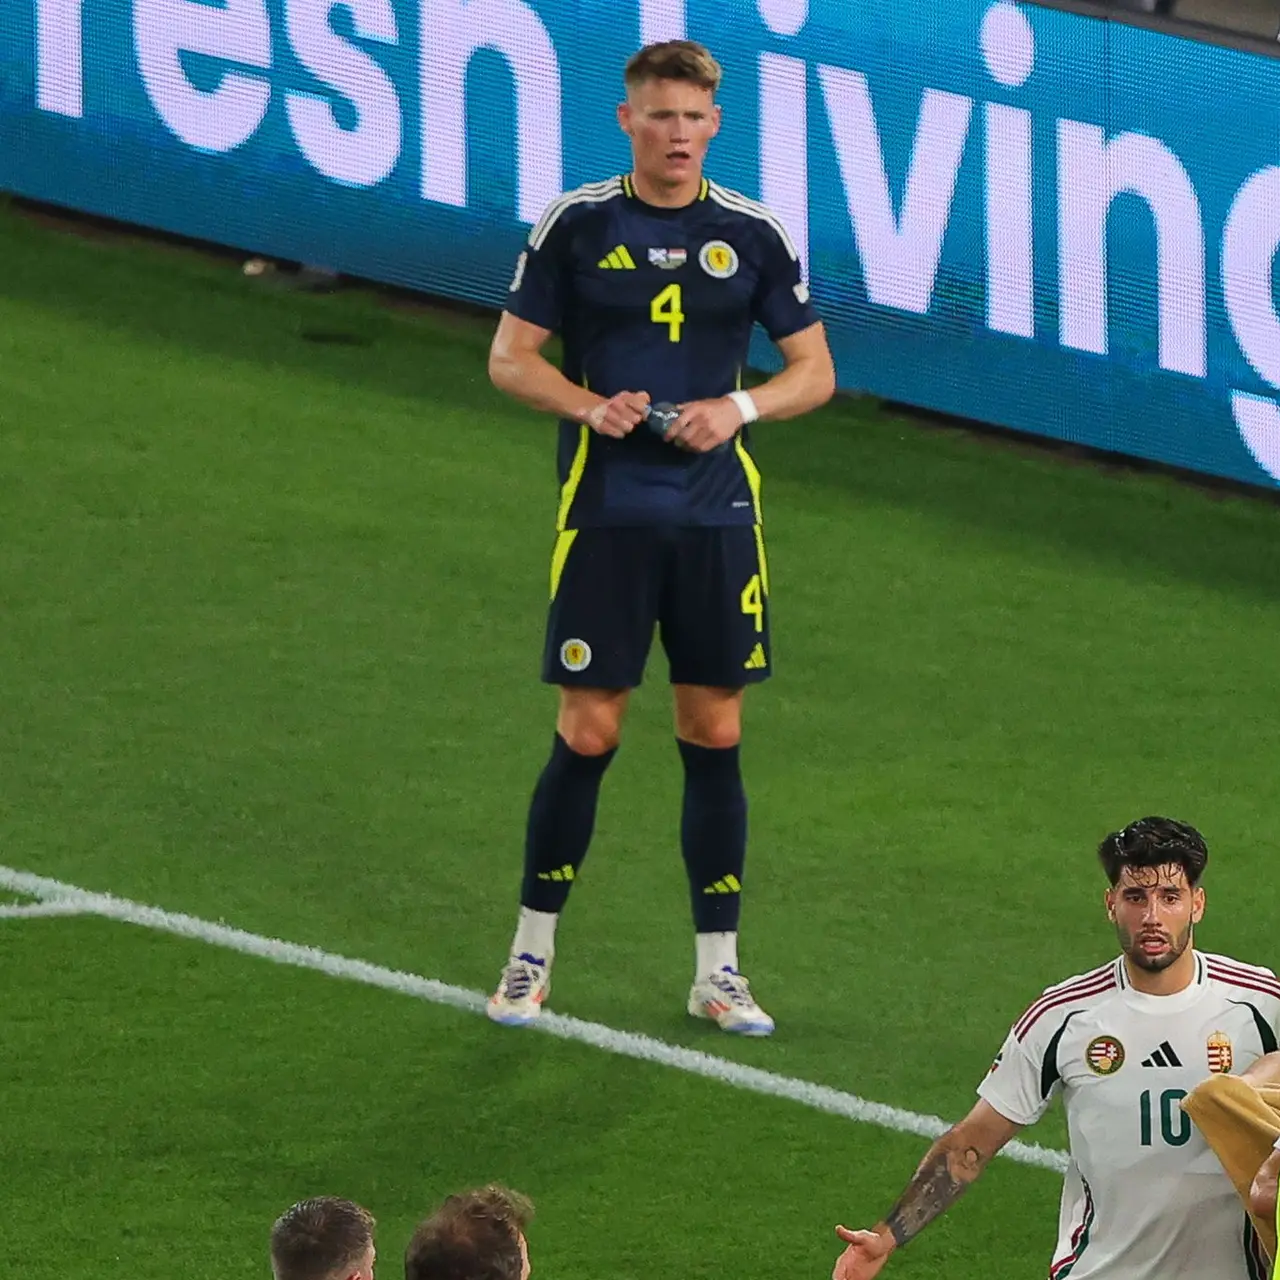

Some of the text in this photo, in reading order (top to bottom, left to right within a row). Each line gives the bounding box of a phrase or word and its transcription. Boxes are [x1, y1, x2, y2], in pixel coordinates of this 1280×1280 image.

[651, 283, 685, 342] 4
[741, 573, 763, 633] 4
[1140, 1088, 1191, 1146] 10
